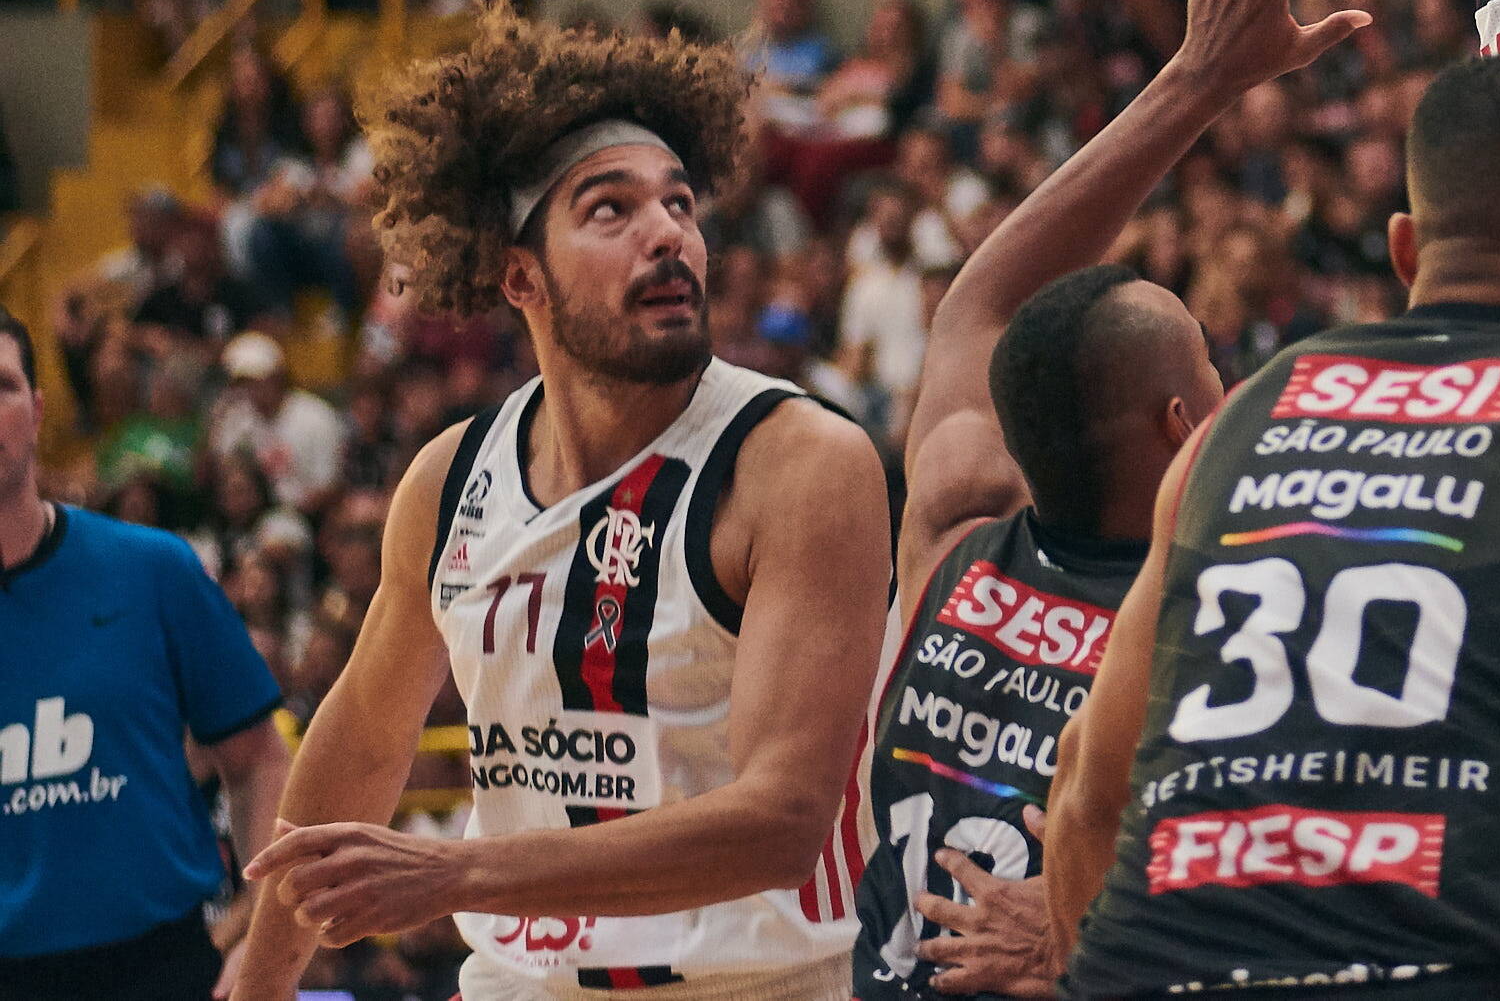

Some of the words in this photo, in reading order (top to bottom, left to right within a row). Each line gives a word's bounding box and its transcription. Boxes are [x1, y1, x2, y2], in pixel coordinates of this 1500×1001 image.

[1254, 418, 1348, 455] SÃO
[1347, 424, 1493, 458] PAULO
[956, 574, 1110, 667] SESI
[917, 632, 986, 679] SÃO
[1168, 557, 1468, 743] 30
[521, 718, 636, 765] SÓCIO
[3, 766, 128, 815] .com.br
[1167, 814, 1420, 880] FIESP
